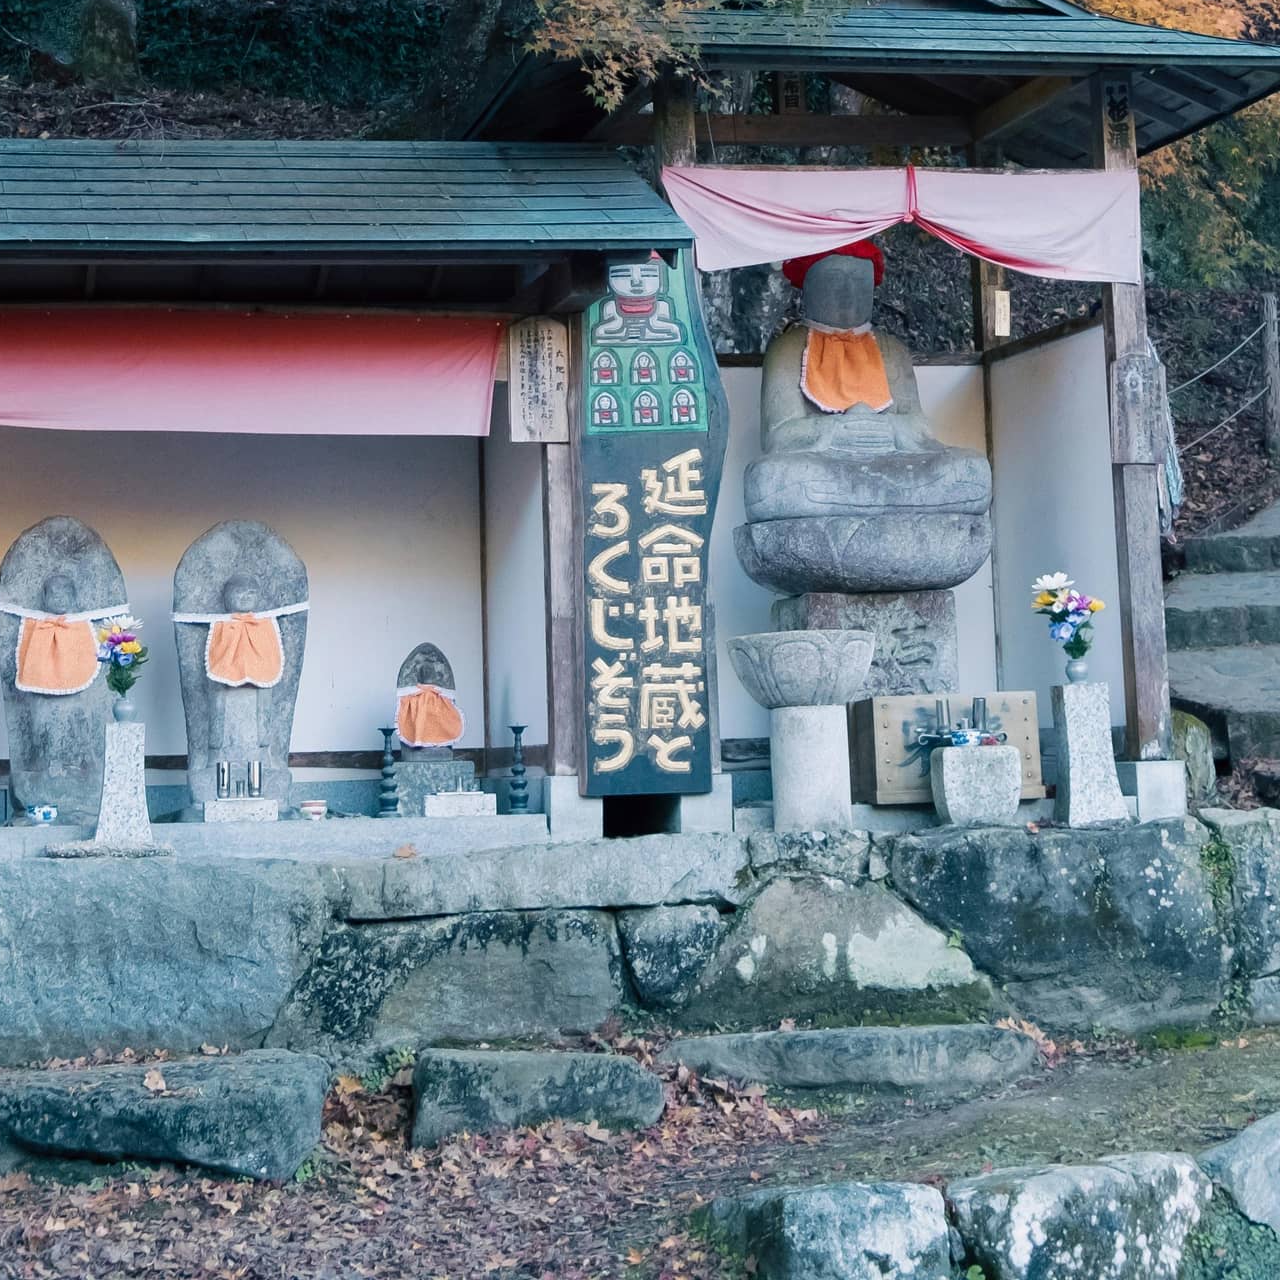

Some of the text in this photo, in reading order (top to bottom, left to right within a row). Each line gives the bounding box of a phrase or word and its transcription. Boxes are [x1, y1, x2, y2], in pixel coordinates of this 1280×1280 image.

[588, 482, 637, 775] ろくじぞう
[637, 447, 709, 774] 延命地蔵と
